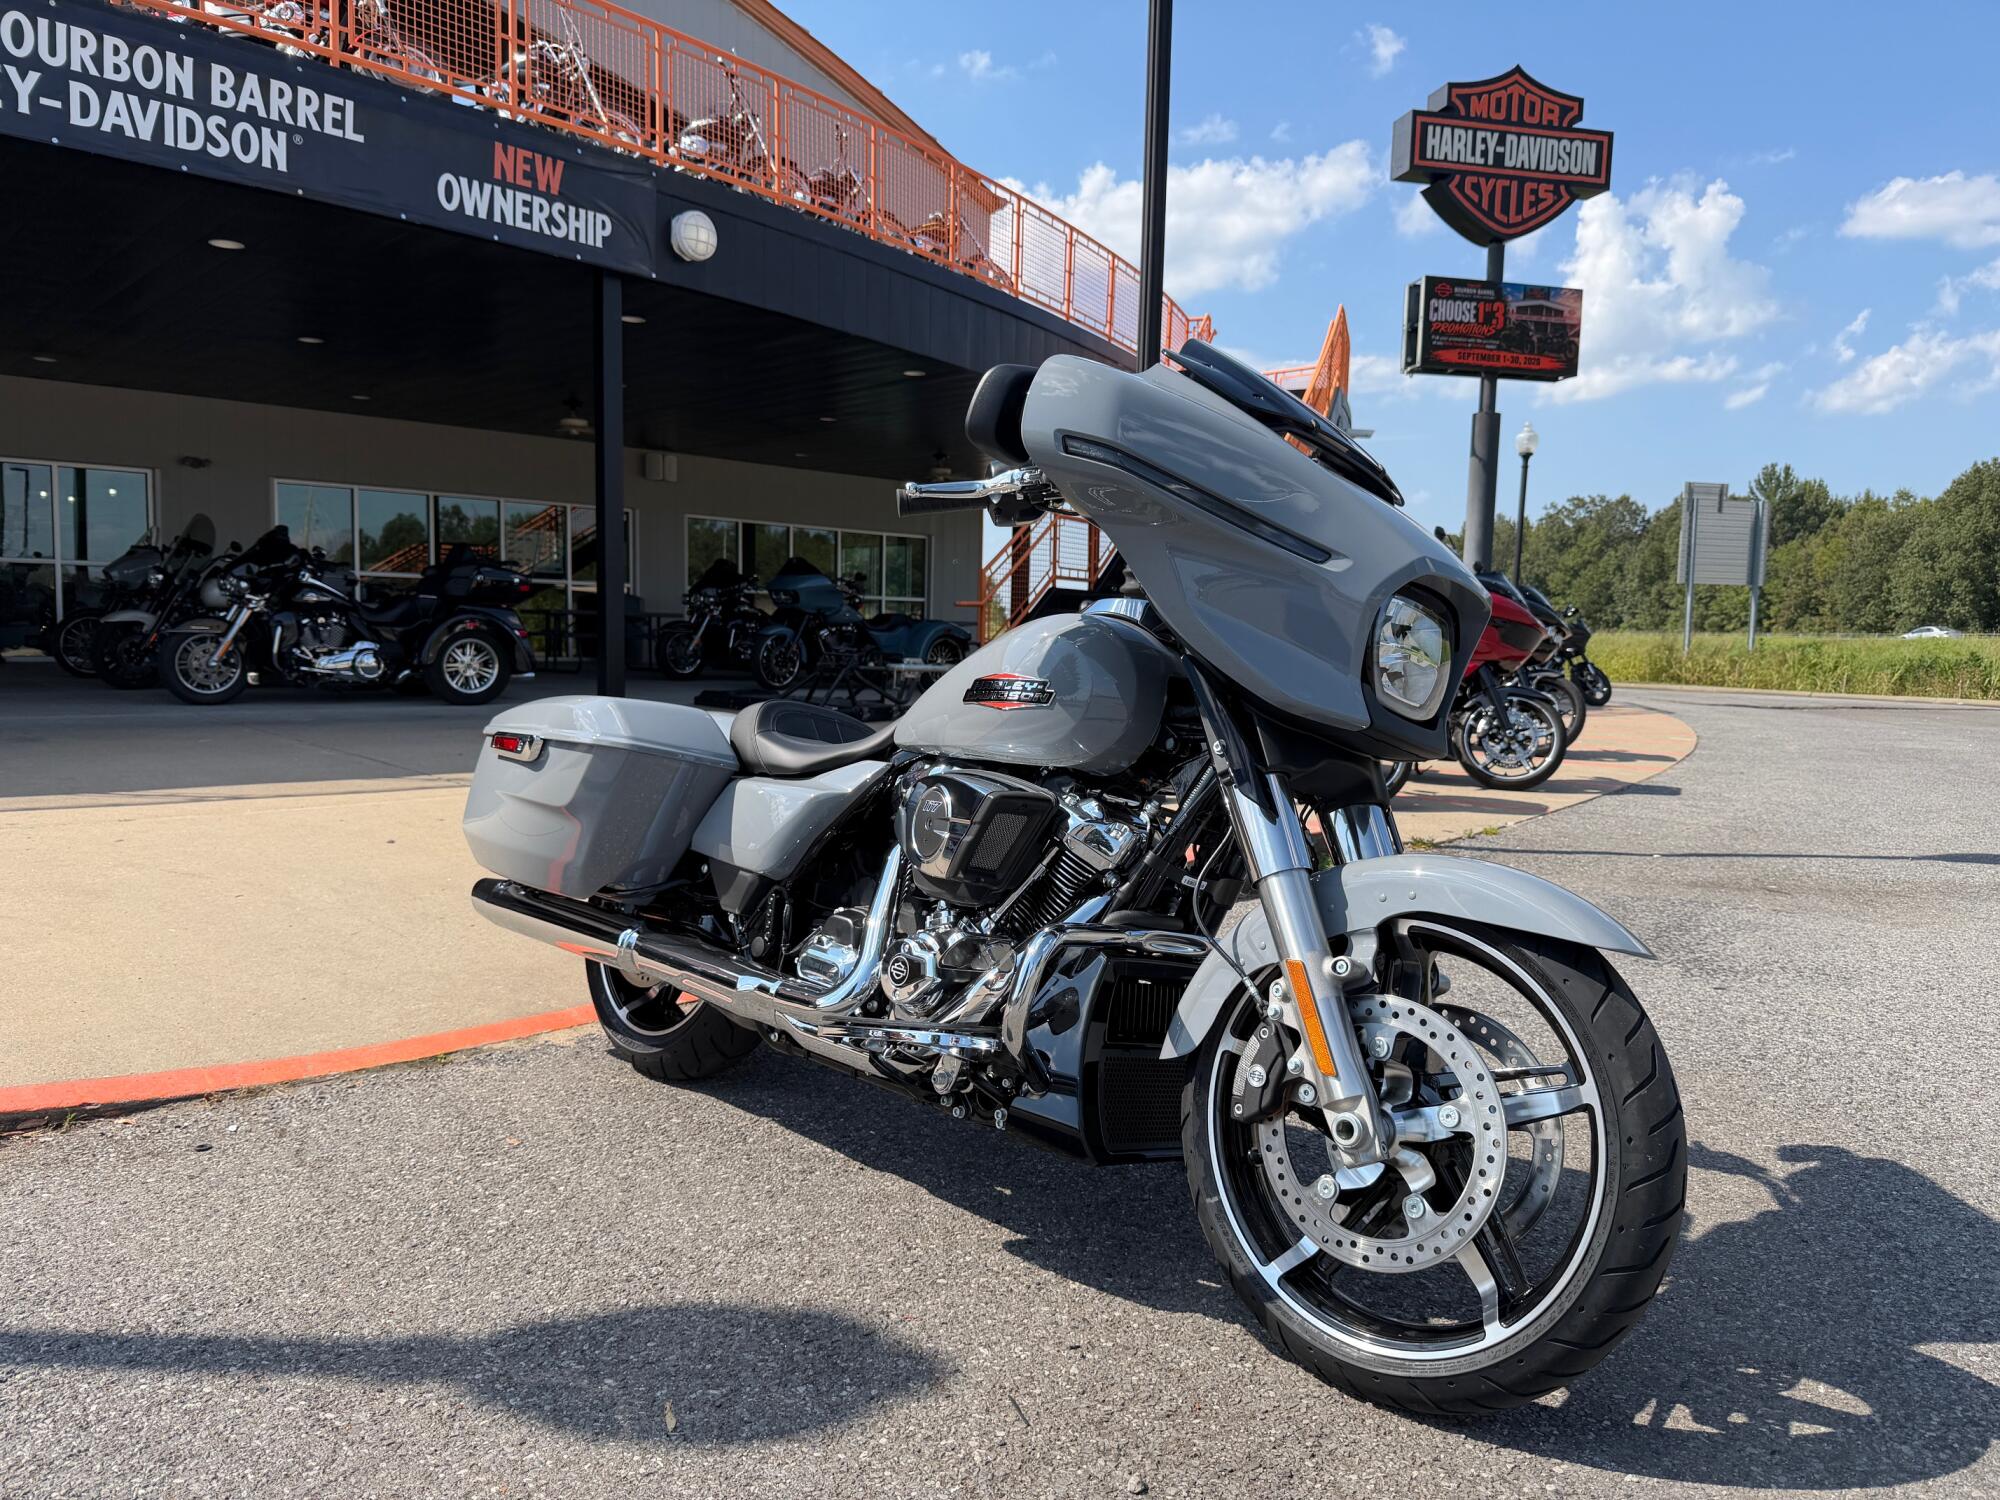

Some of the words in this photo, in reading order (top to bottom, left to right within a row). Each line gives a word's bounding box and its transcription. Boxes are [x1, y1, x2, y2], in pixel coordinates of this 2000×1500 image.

[0, 10, 195, 100] OURBON
[210, 64, 365, 144] BARREL
[1470, 84, 1559, 127] MOTOR
[1426, 125, 1597, 175] HARLEY-DAVIDSON
[493, 142, 564, 196] NEW
[437, 173, 612, 249] OWNERSHIP
[1464, 175, 1555, 224] CYCLES
[1429, 299, 1477, 323] CHOOSE
[1478, 302, 1485, 323] 1
[1492, 302, 1505, 330] 3
[1431, 322, 1496, 337] PROMOTIONS
[1457, 351, 1501, 362] SEPTEMBER
[966, 689, 1049, 703] IDSON
[974, 680, 1043, 691] RLEY-
[922, 799, 943, 813] 117
